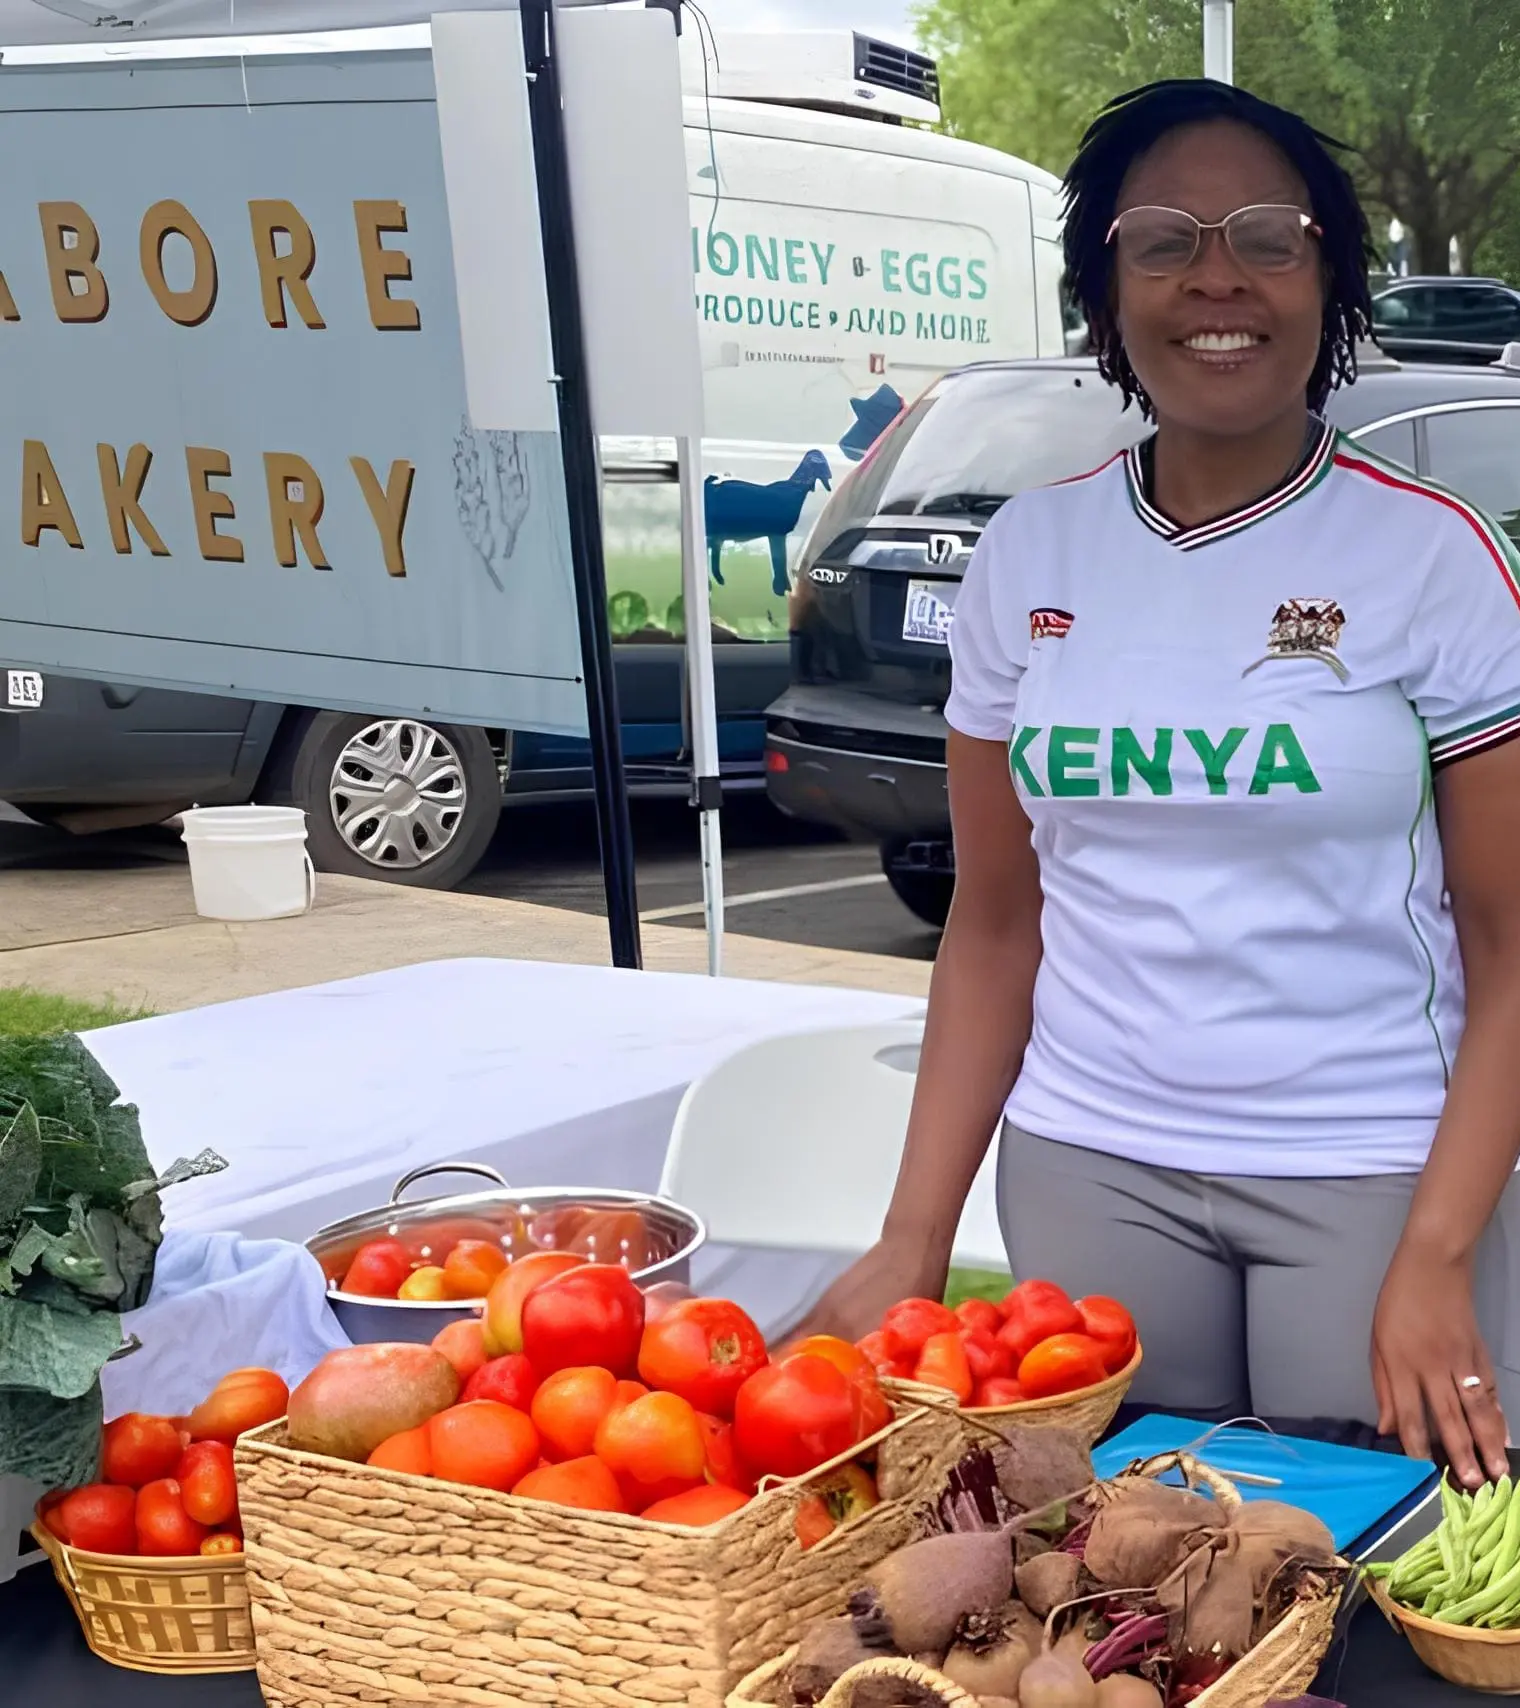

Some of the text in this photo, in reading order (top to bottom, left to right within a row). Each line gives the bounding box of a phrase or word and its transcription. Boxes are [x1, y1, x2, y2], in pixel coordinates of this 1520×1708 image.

[880, 248, 988, 301] EGGS
[695, 294, 821, 329] RODUCE
[844, 307, 906, 337] AND
[21, 439, 415, 578] AKERY
[1009, 723, 1323, 797] KENYA
